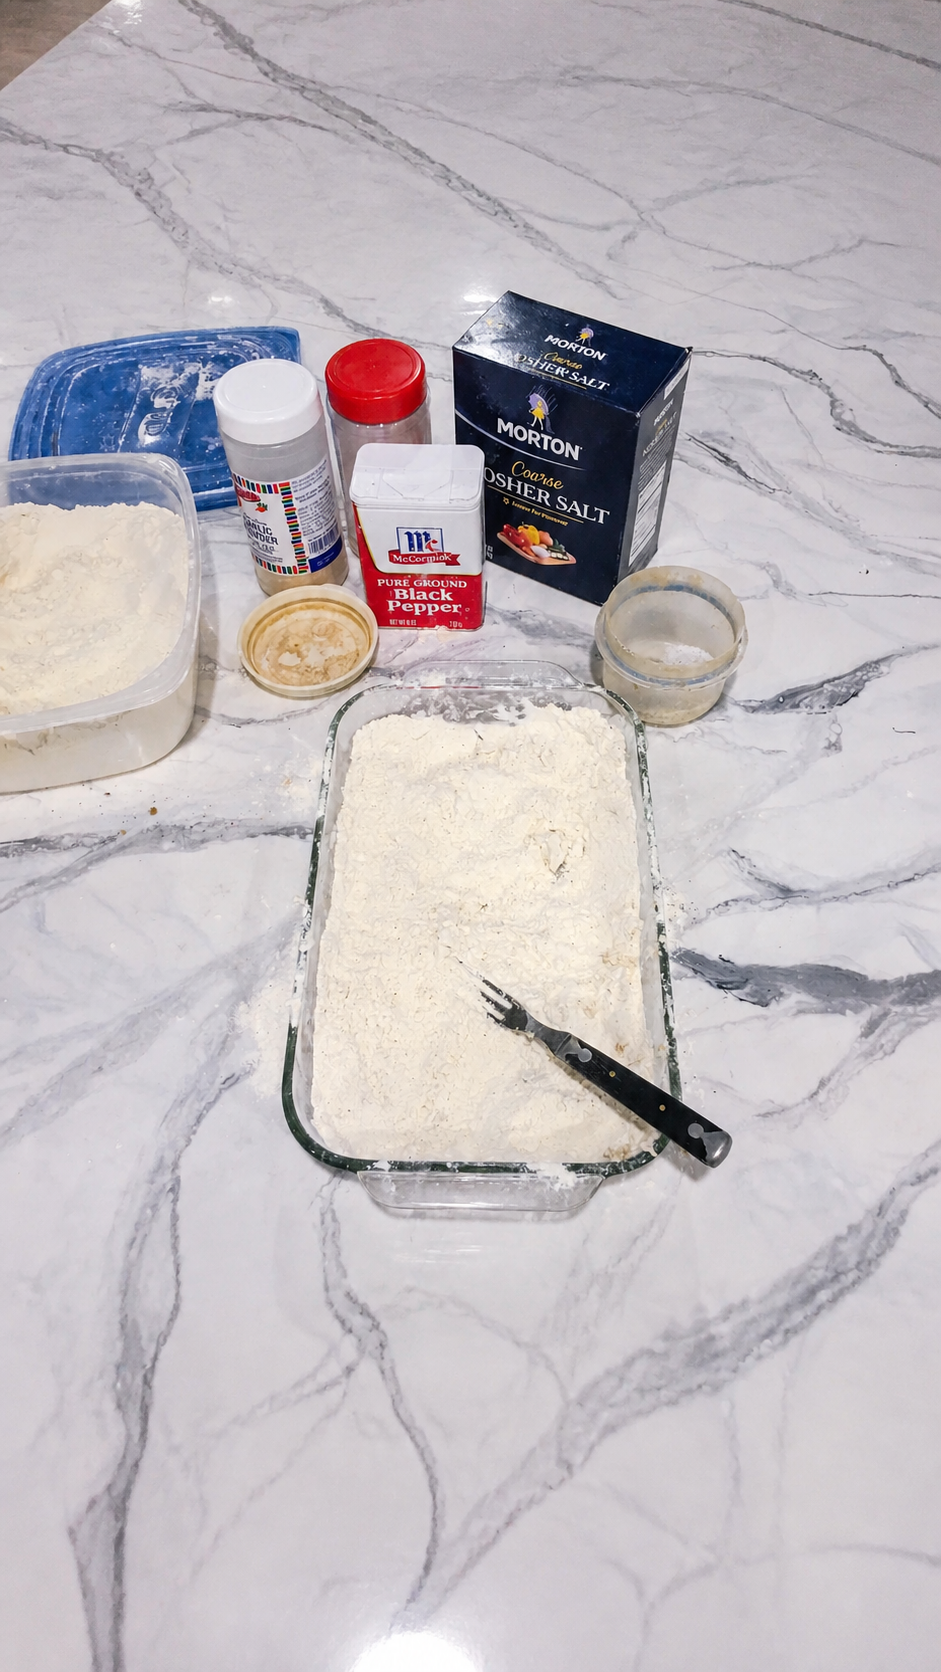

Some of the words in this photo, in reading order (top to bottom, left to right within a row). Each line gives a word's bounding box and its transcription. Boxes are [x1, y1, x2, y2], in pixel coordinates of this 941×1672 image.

[544, 334, 607, 361] MORTON
[569, 371, 610, 390] SALT
[497, 417, 580, 461] MORTON
[511, 461, 564, 490] Coarse
[484, 467, 551, 507] OSHER
[556, 495, 611, 524] SALT
[377, 579, 410, 588] PURE
[413, 579, 468, 589] GROUND
[393, 587, 454, 601] Black
[387, 600, 462, 616] Pepper
